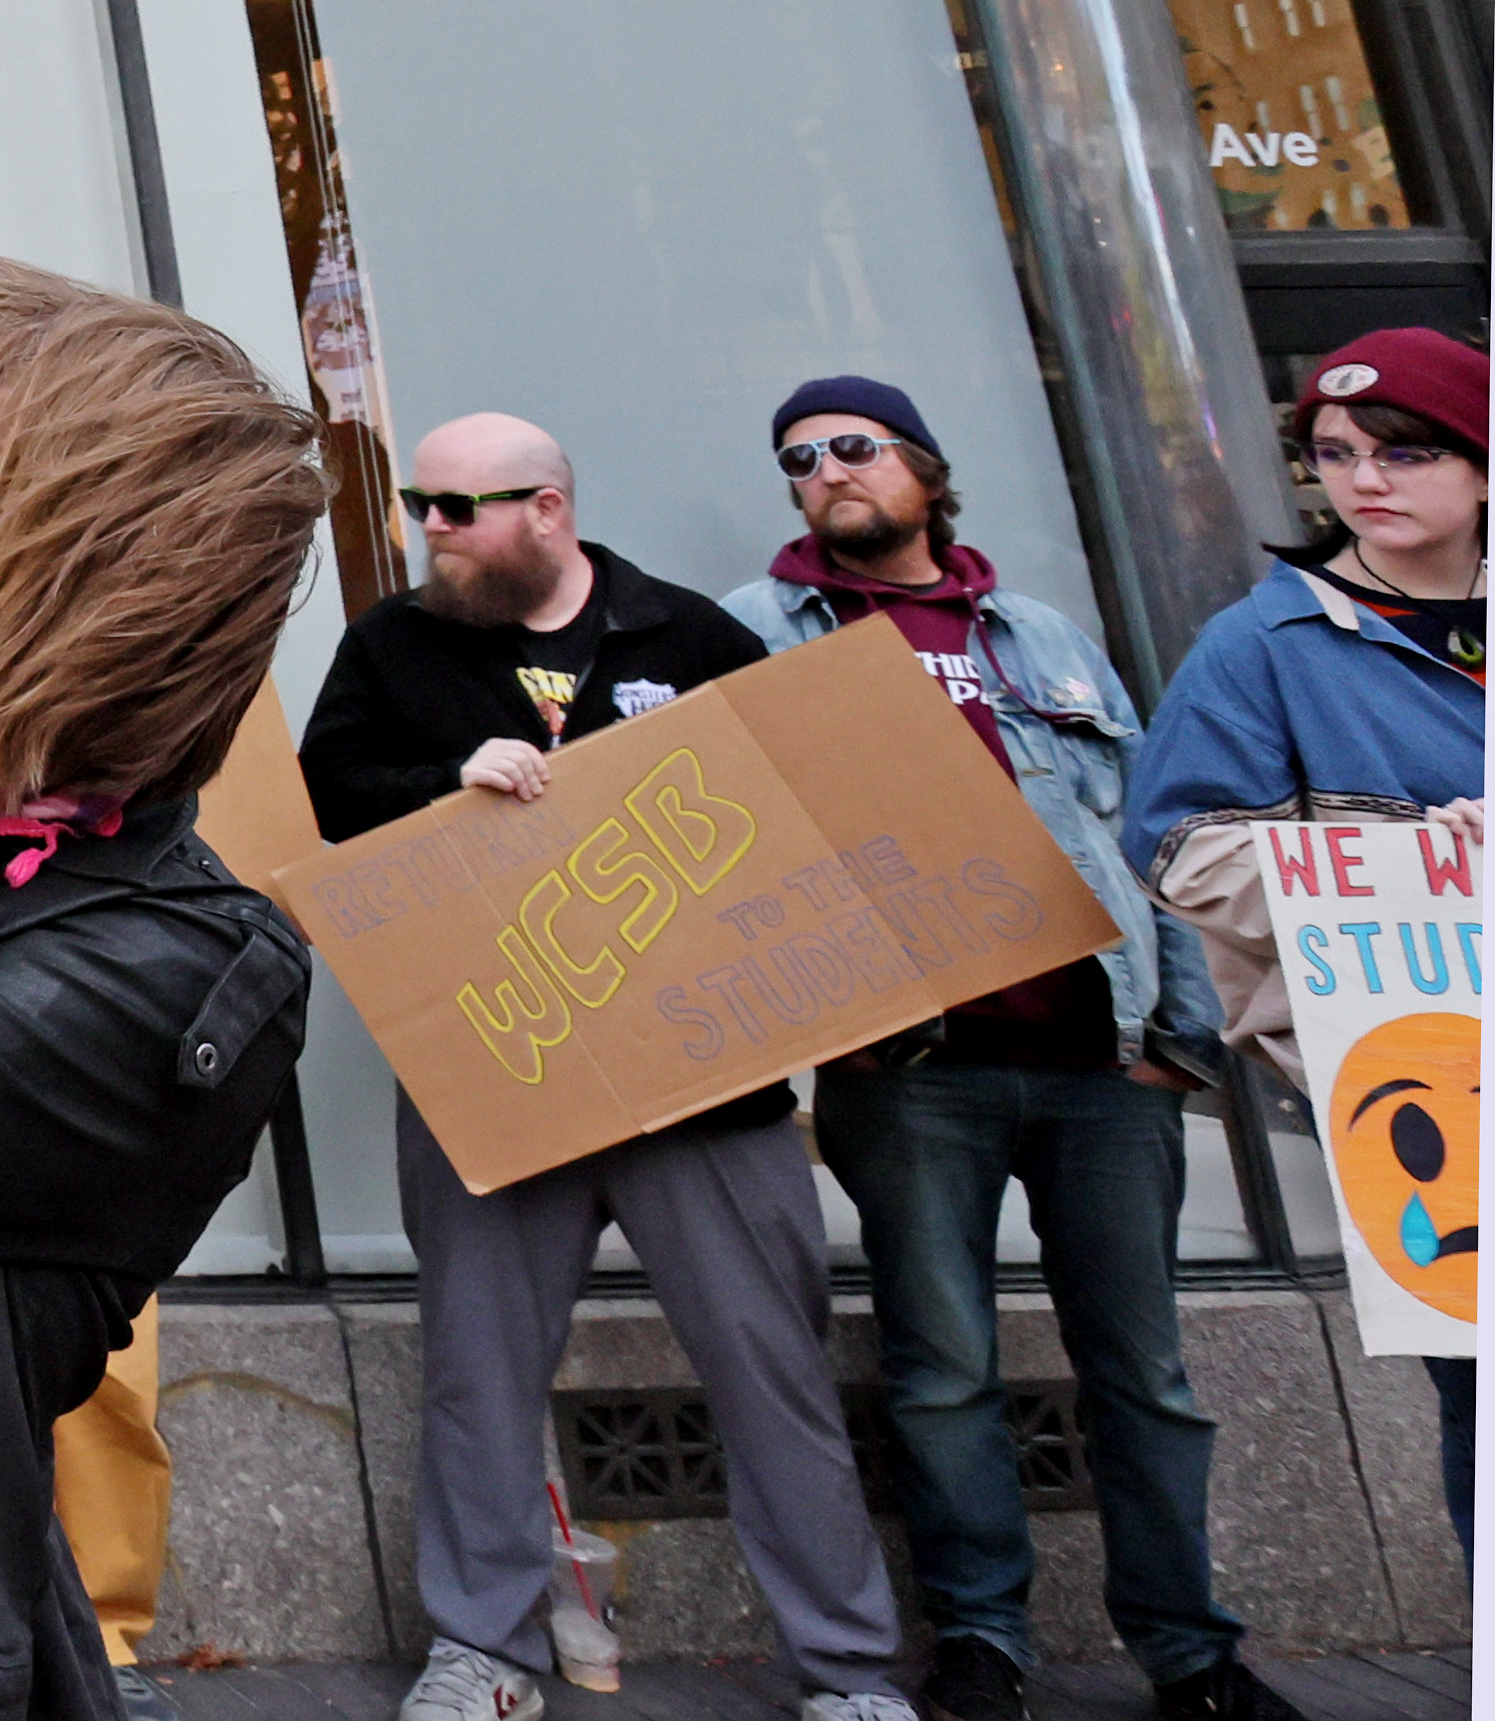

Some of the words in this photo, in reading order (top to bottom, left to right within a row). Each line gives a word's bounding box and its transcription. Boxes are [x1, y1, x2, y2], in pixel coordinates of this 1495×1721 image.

[1209, 122, 1320, 168] Ave
[311, 796, 576, 940] RETURN
[455, 747, 756, 1085] WCSB
[717, 892, 786, 941] TO
[781, 834, 918, 913] THE
[1268, 826, 1376, 898] WE
[654, 857, 1045, 1061] STUDENTS
